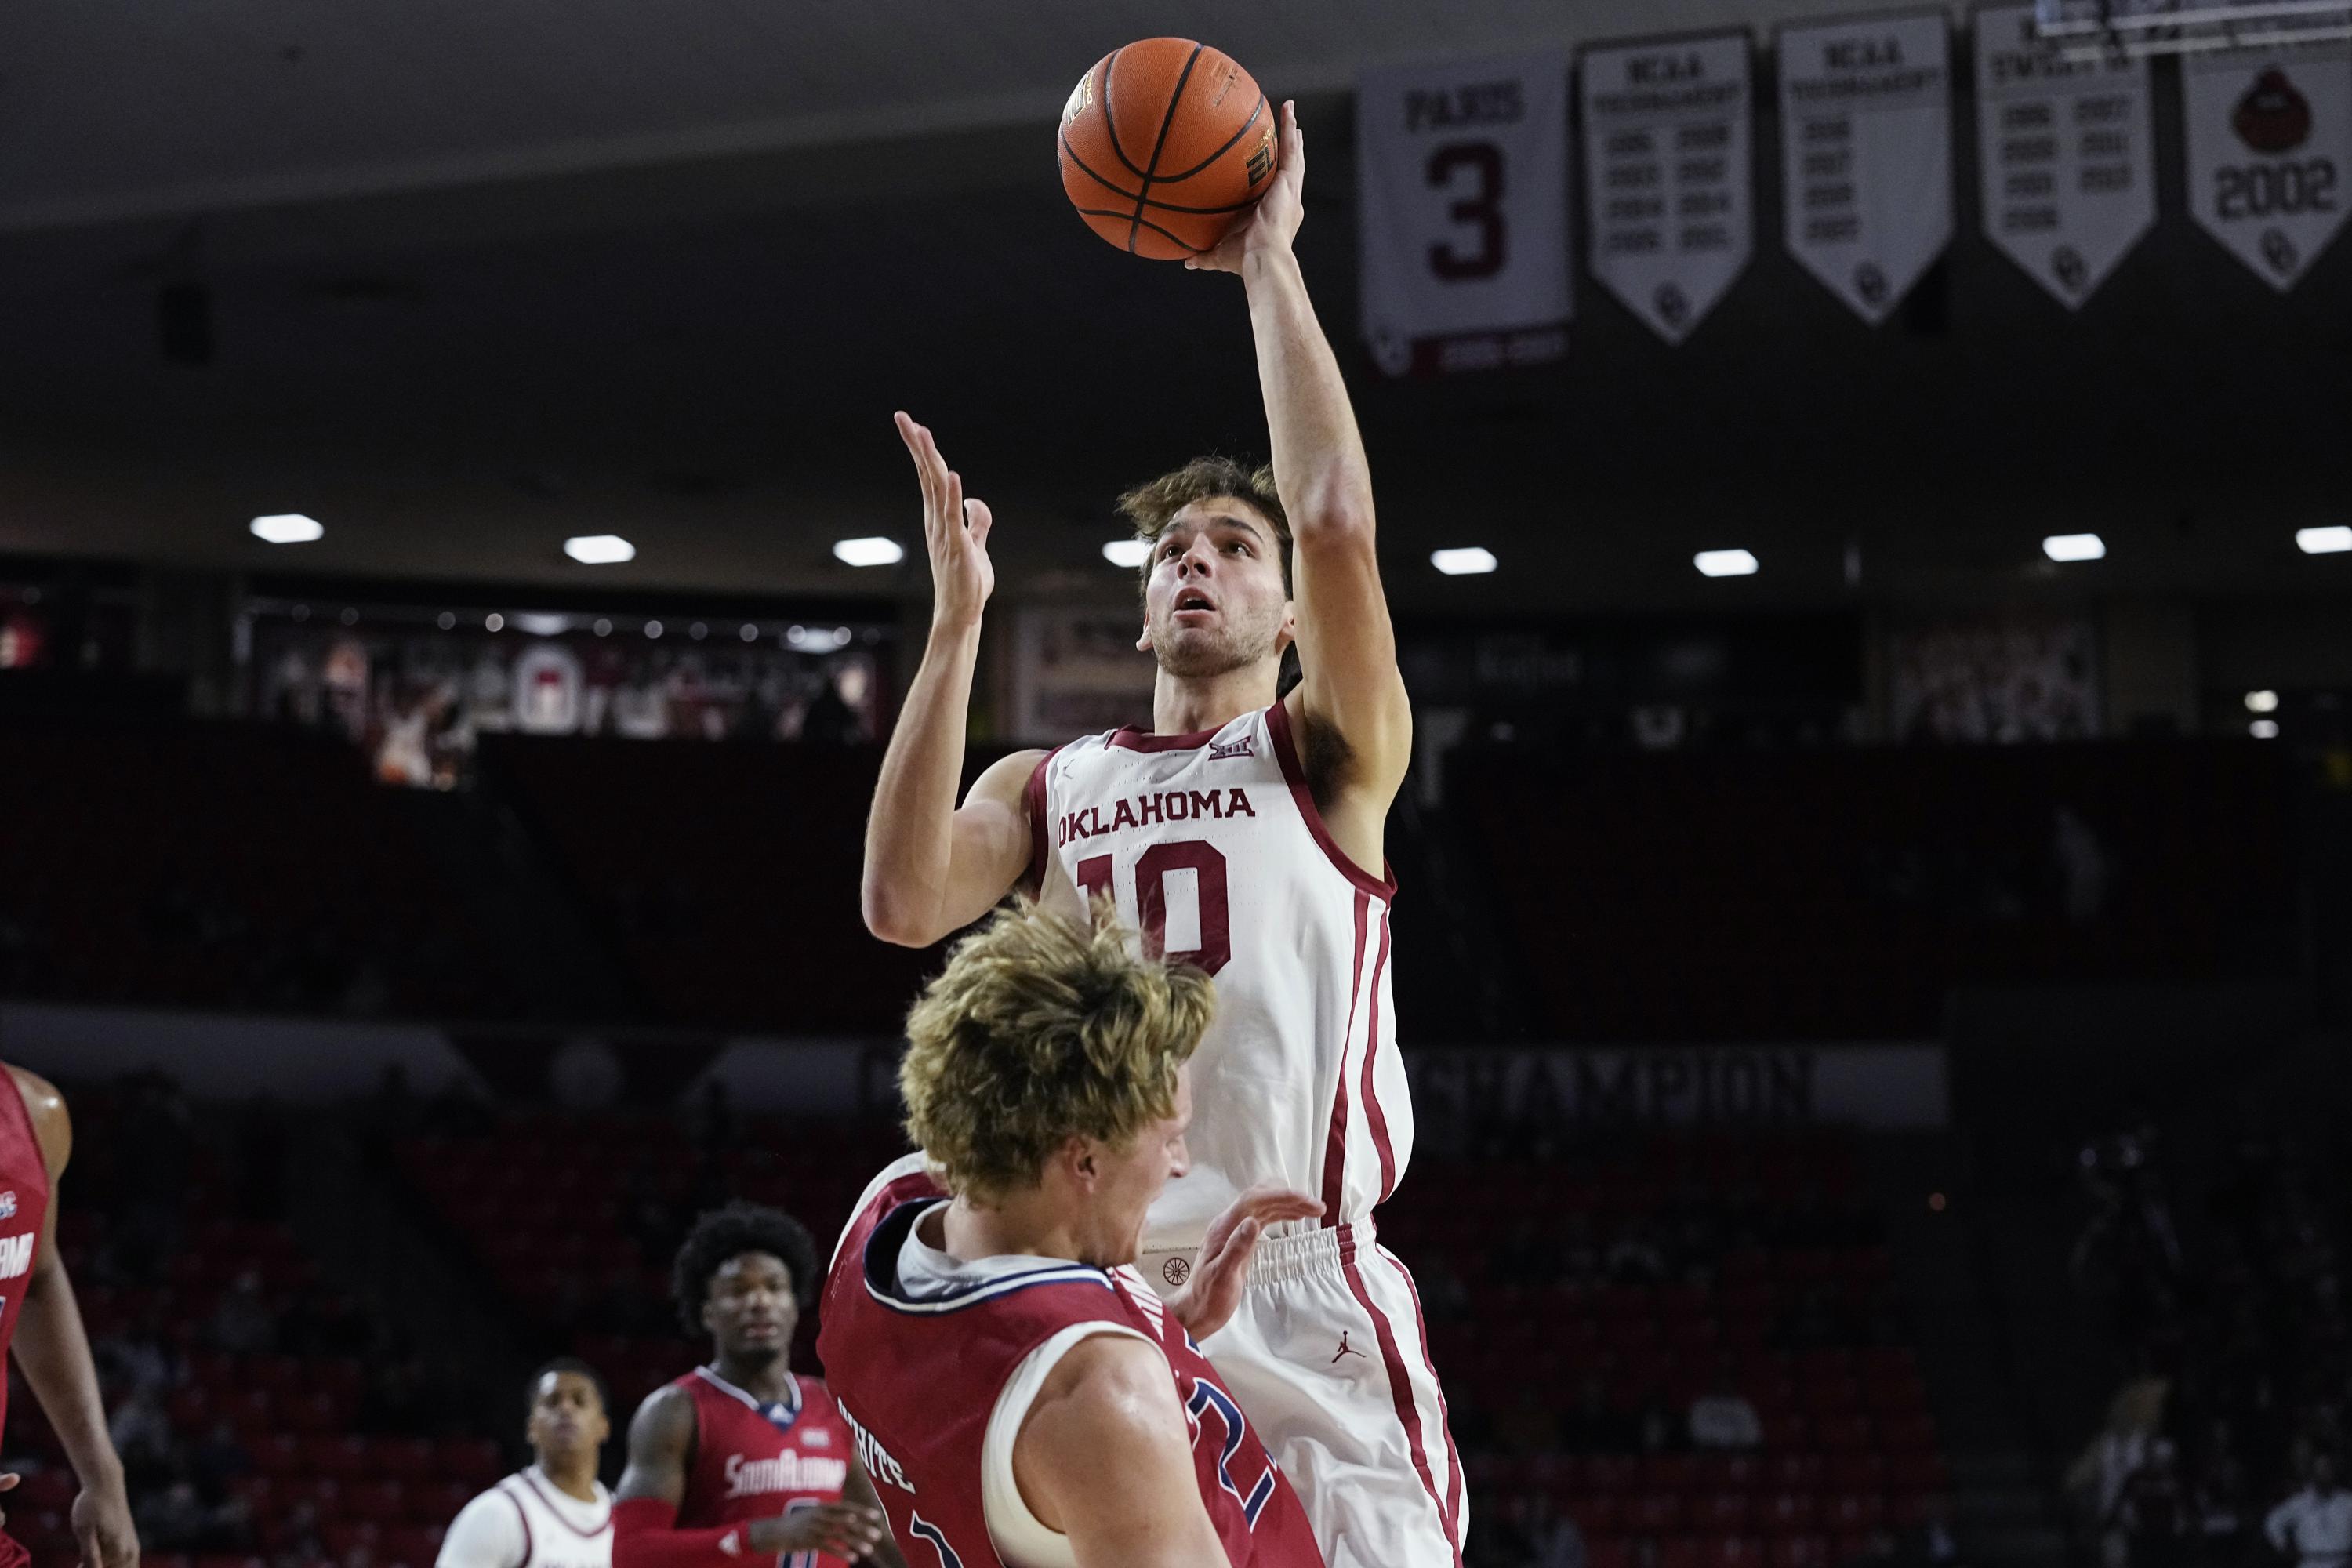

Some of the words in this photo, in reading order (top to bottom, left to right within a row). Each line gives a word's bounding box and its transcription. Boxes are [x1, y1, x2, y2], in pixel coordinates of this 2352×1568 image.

[1406, 79, 1525, 133] PARIS
[1425, 140, 1506, 285] 3
[2214, 158, 2338, 220] 2002
[1058, 788, 1256, 849] OKLAHOMA
[1076, 840, 1232, 978] 10
